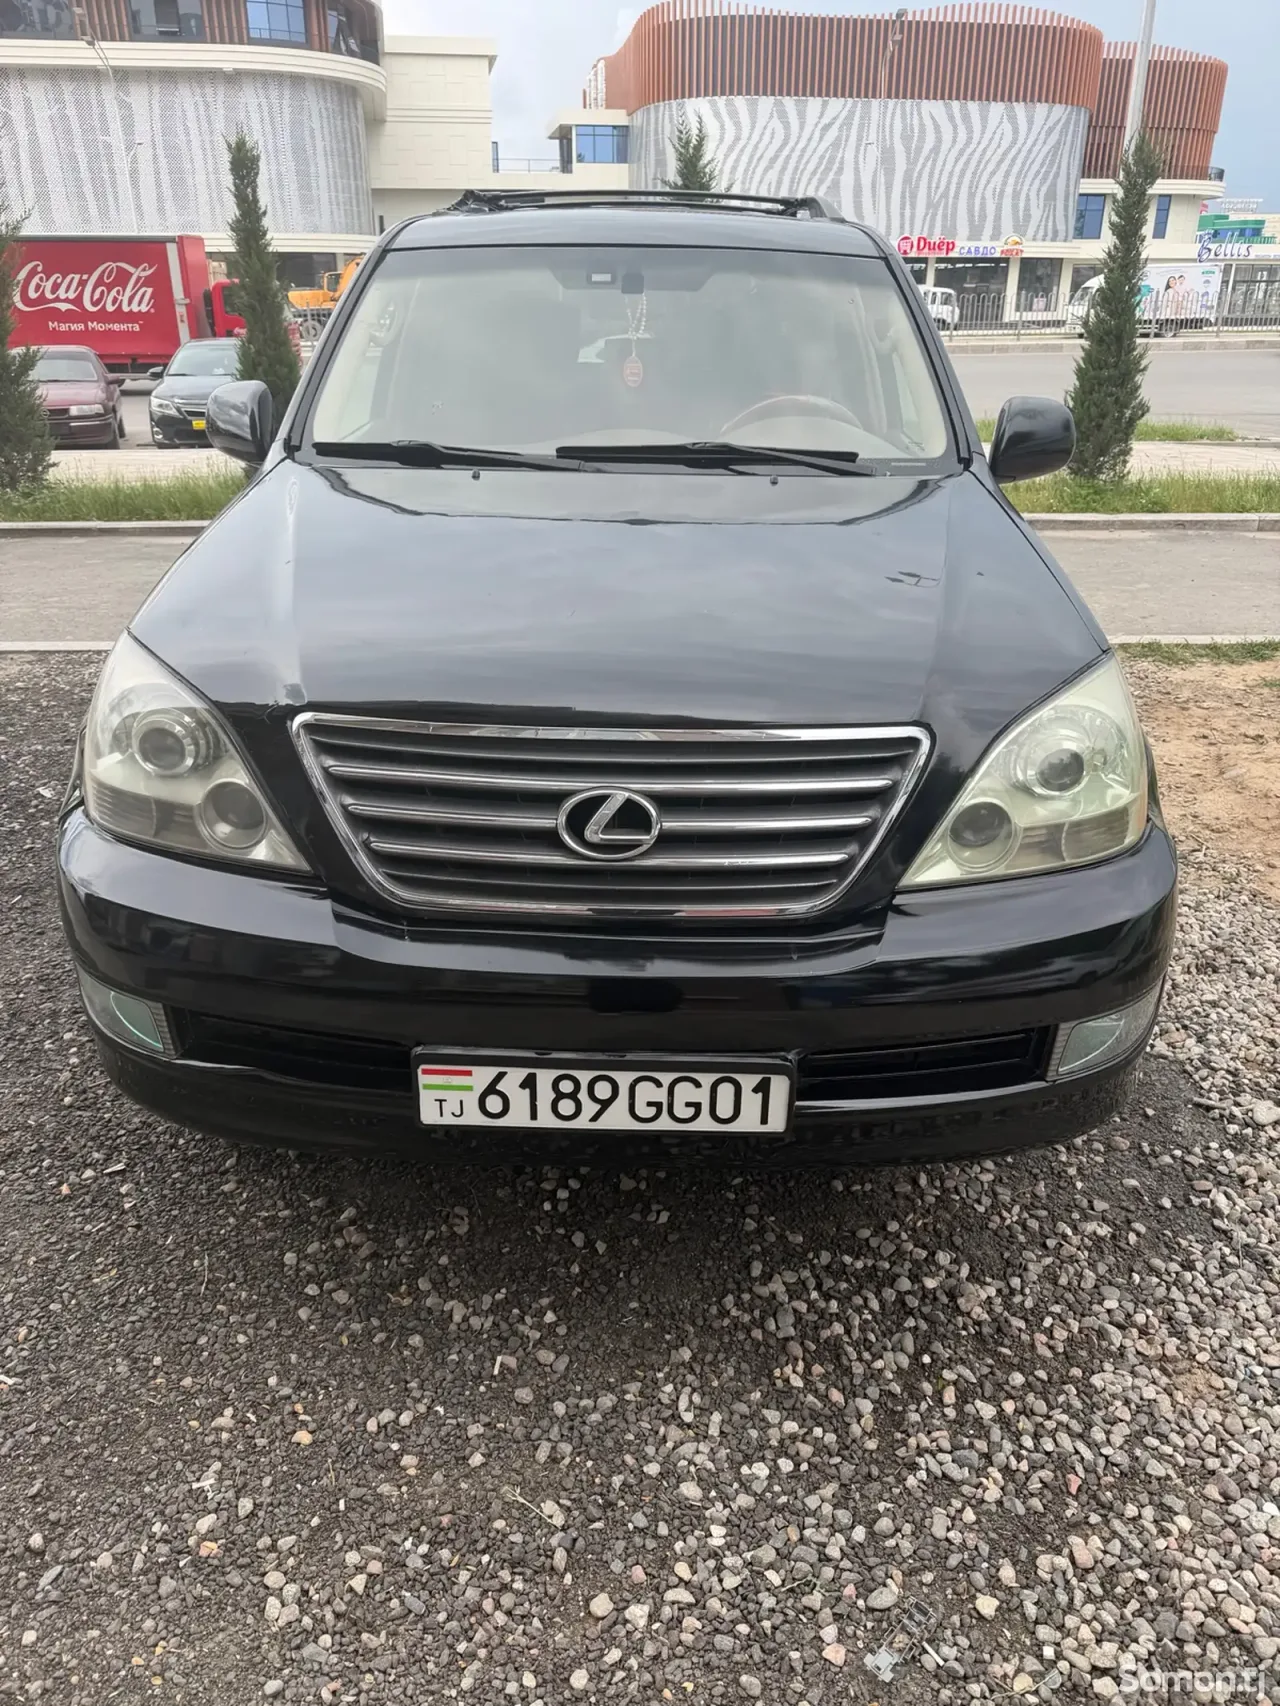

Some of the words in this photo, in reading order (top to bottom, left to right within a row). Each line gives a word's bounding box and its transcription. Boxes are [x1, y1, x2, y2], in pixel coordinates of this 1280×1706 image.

[959, 246, 997, 256] САВДО
[1196, 230, 1252, 263] Bellis
[12, 260, 158, 313] Coca-Cola
[48, 320, 85, 332] Магия
[434, 1098, 464, 1118] TJ
[478, 1071, 772, 1126] 6189GG01
